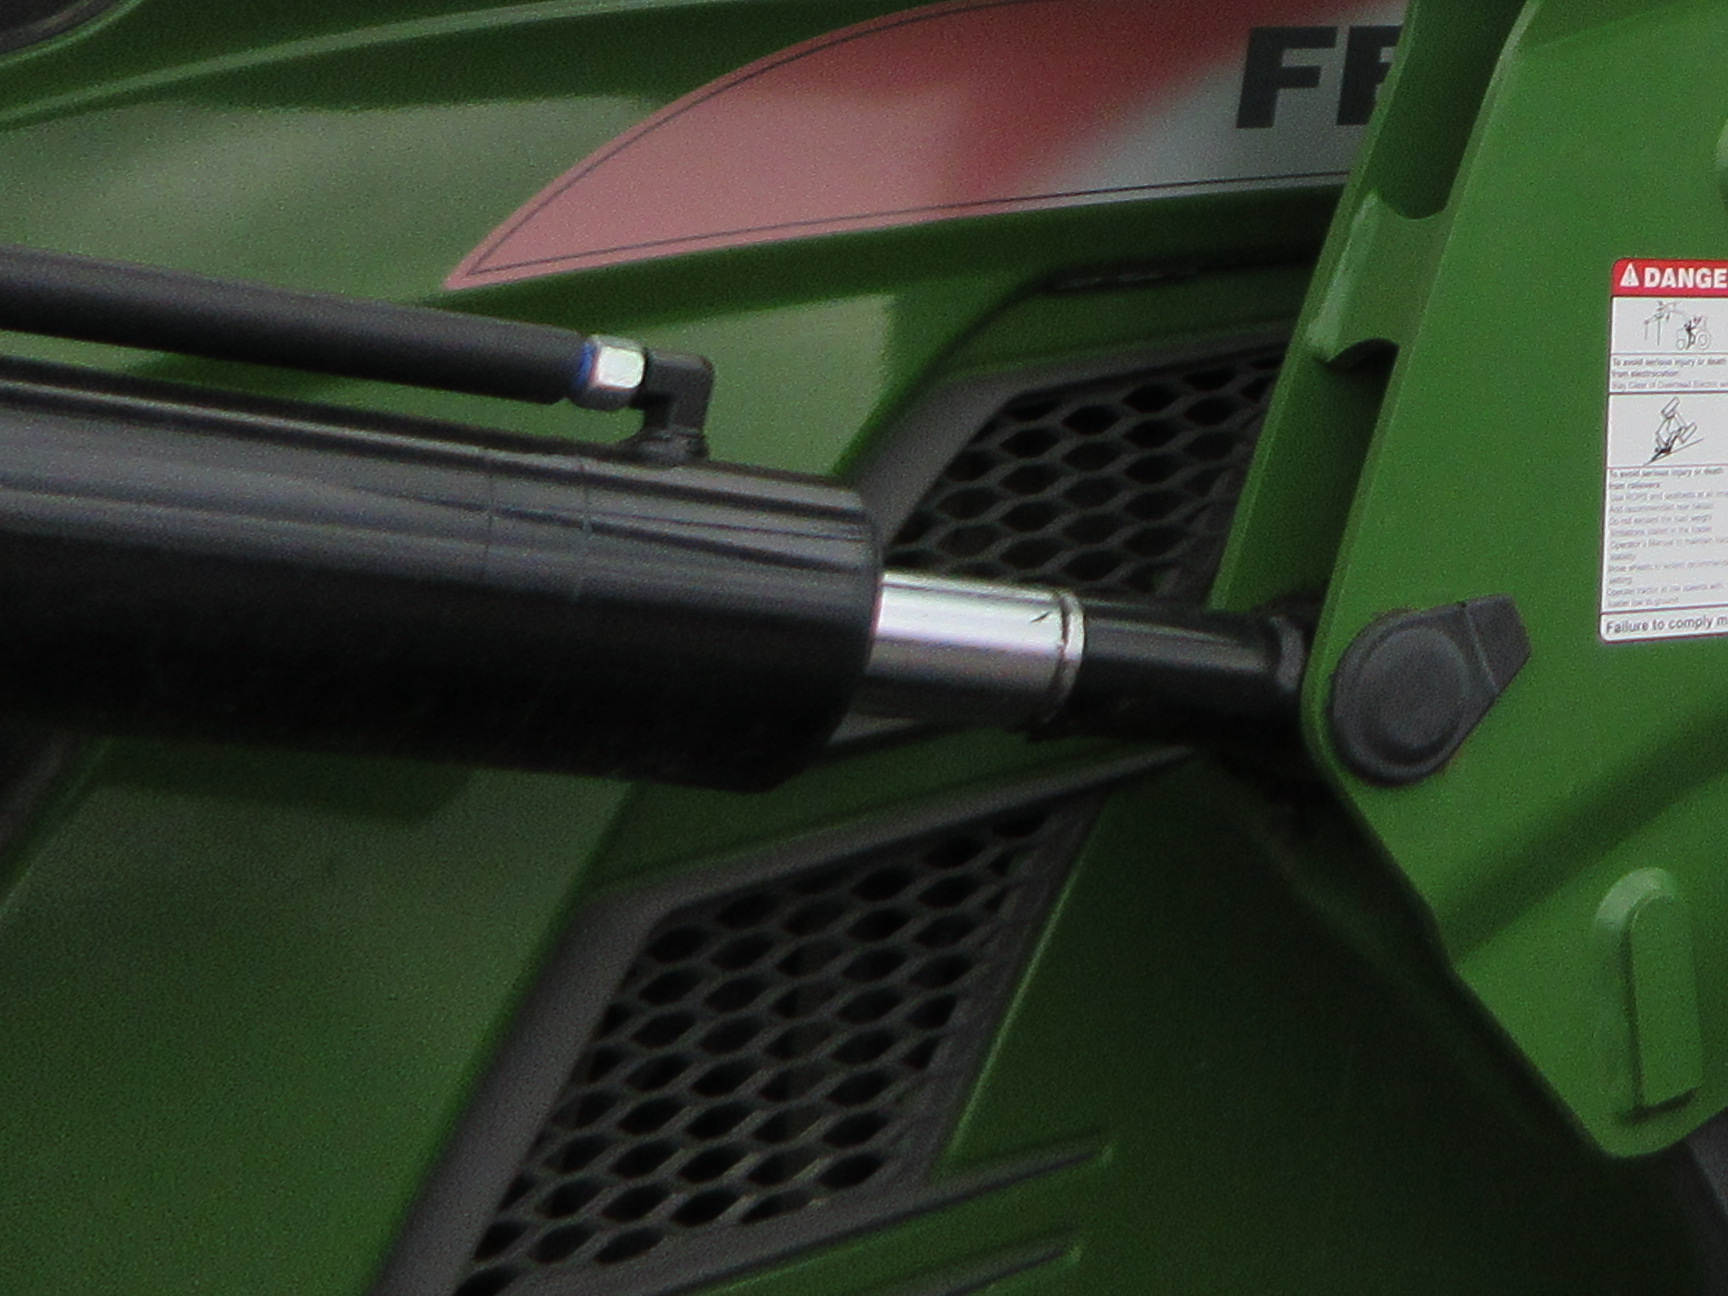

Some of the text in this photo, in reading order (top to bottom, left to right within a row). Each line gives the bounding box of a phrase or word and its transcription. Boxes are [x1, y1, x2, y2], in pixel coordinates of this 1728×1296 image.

[1606, 620, 1648, 634] Failure
[1652, 619, 1664, 630] to
[1668, 615, 1713, 631] comply
